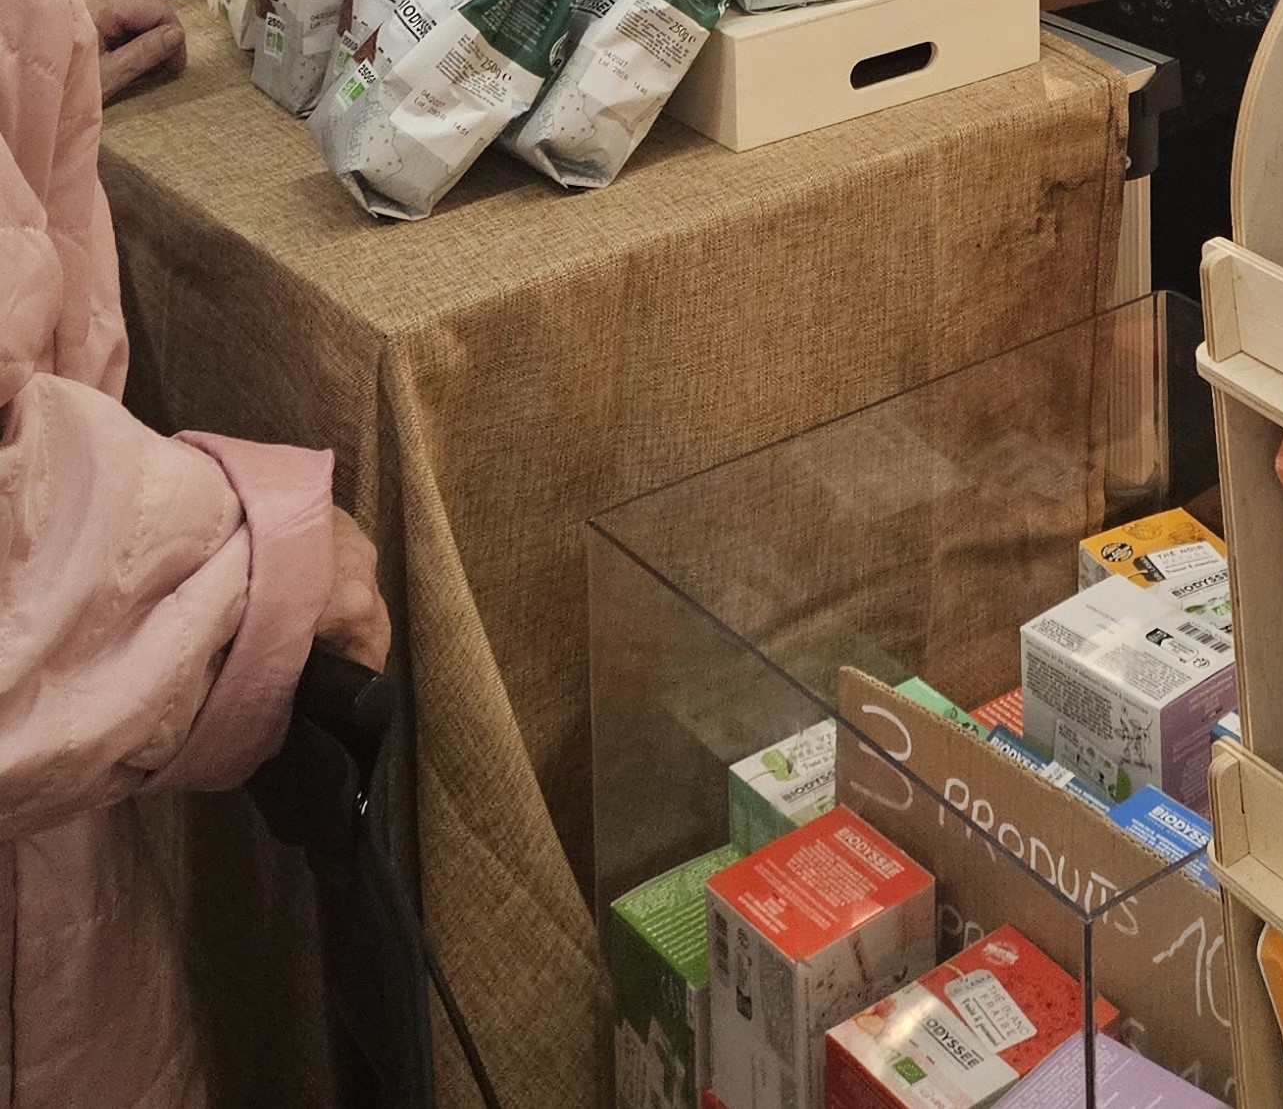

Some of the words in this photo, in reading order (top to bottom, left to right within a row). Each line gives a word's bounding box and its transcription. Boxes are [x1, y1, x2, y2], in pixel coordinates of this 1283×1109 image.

[669, 21, 690, 43] 250g
[480, 56, 502, 79] 250g
[833, 827, 904, 878] BIODYSSEE
[938, 778, 1140, 936] PRODUITS
